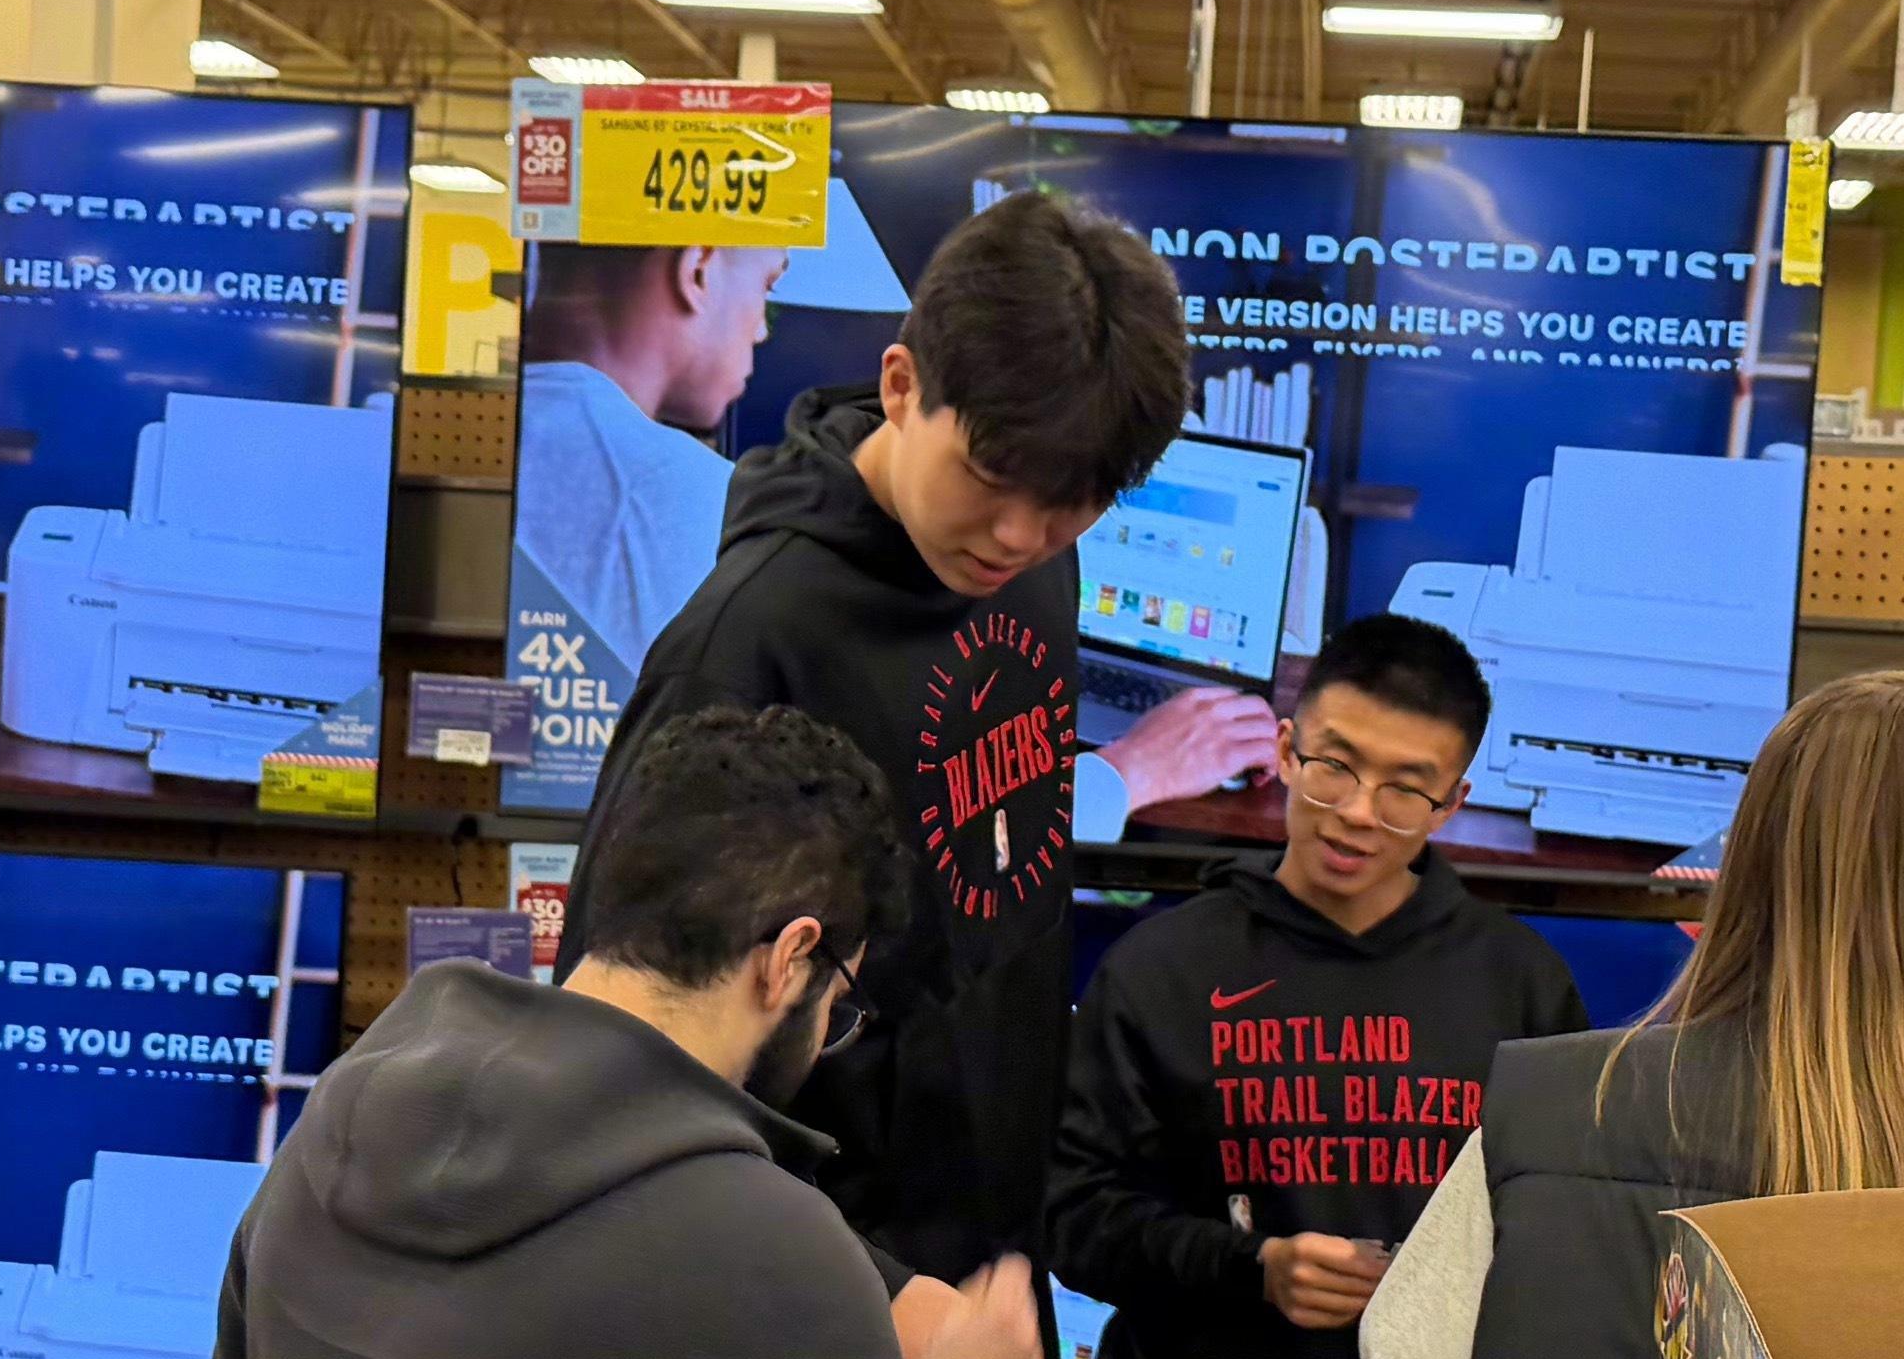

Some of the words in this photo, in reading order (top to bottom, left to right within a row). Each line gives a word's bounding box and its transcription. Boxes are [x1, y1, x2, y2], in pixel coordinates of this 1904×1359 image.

[680, 90, 730, 108] SALE
[523, 156, 567, 174] OFF
[525, 135, 566, 156] $30
[644, 149, 767, 213] 429.99
[1152, 227, 1281, 262] NON
[5, 257, 117, 294] HELPS
[128, 264, 203, 298] YOU
[215, 271, 351, 306] CREATE
[1217, 295, 1377, 332] VERSION
[1390, 303, 1506, 339] HELPS
[1517, 310, 1596, 344] YOU
[1608, 315, 1749, 350] CREATE
[519, 610, 567, 627] EARN
[518, 632, 585, 674] 4X
[917, 664, 953, 774] TRAIL
[942, 705, 1054, 829] BLAZERS
[58, 1026, 131, 1059] YOU
[142, 1032, 277, 1067] CREATE
[1210, 1015, 1413, 1066] PORTLAND
[1214, 1075, 1328, 1125] TRAIL
[1344, 1075, 1482, 1127] BLAZER
